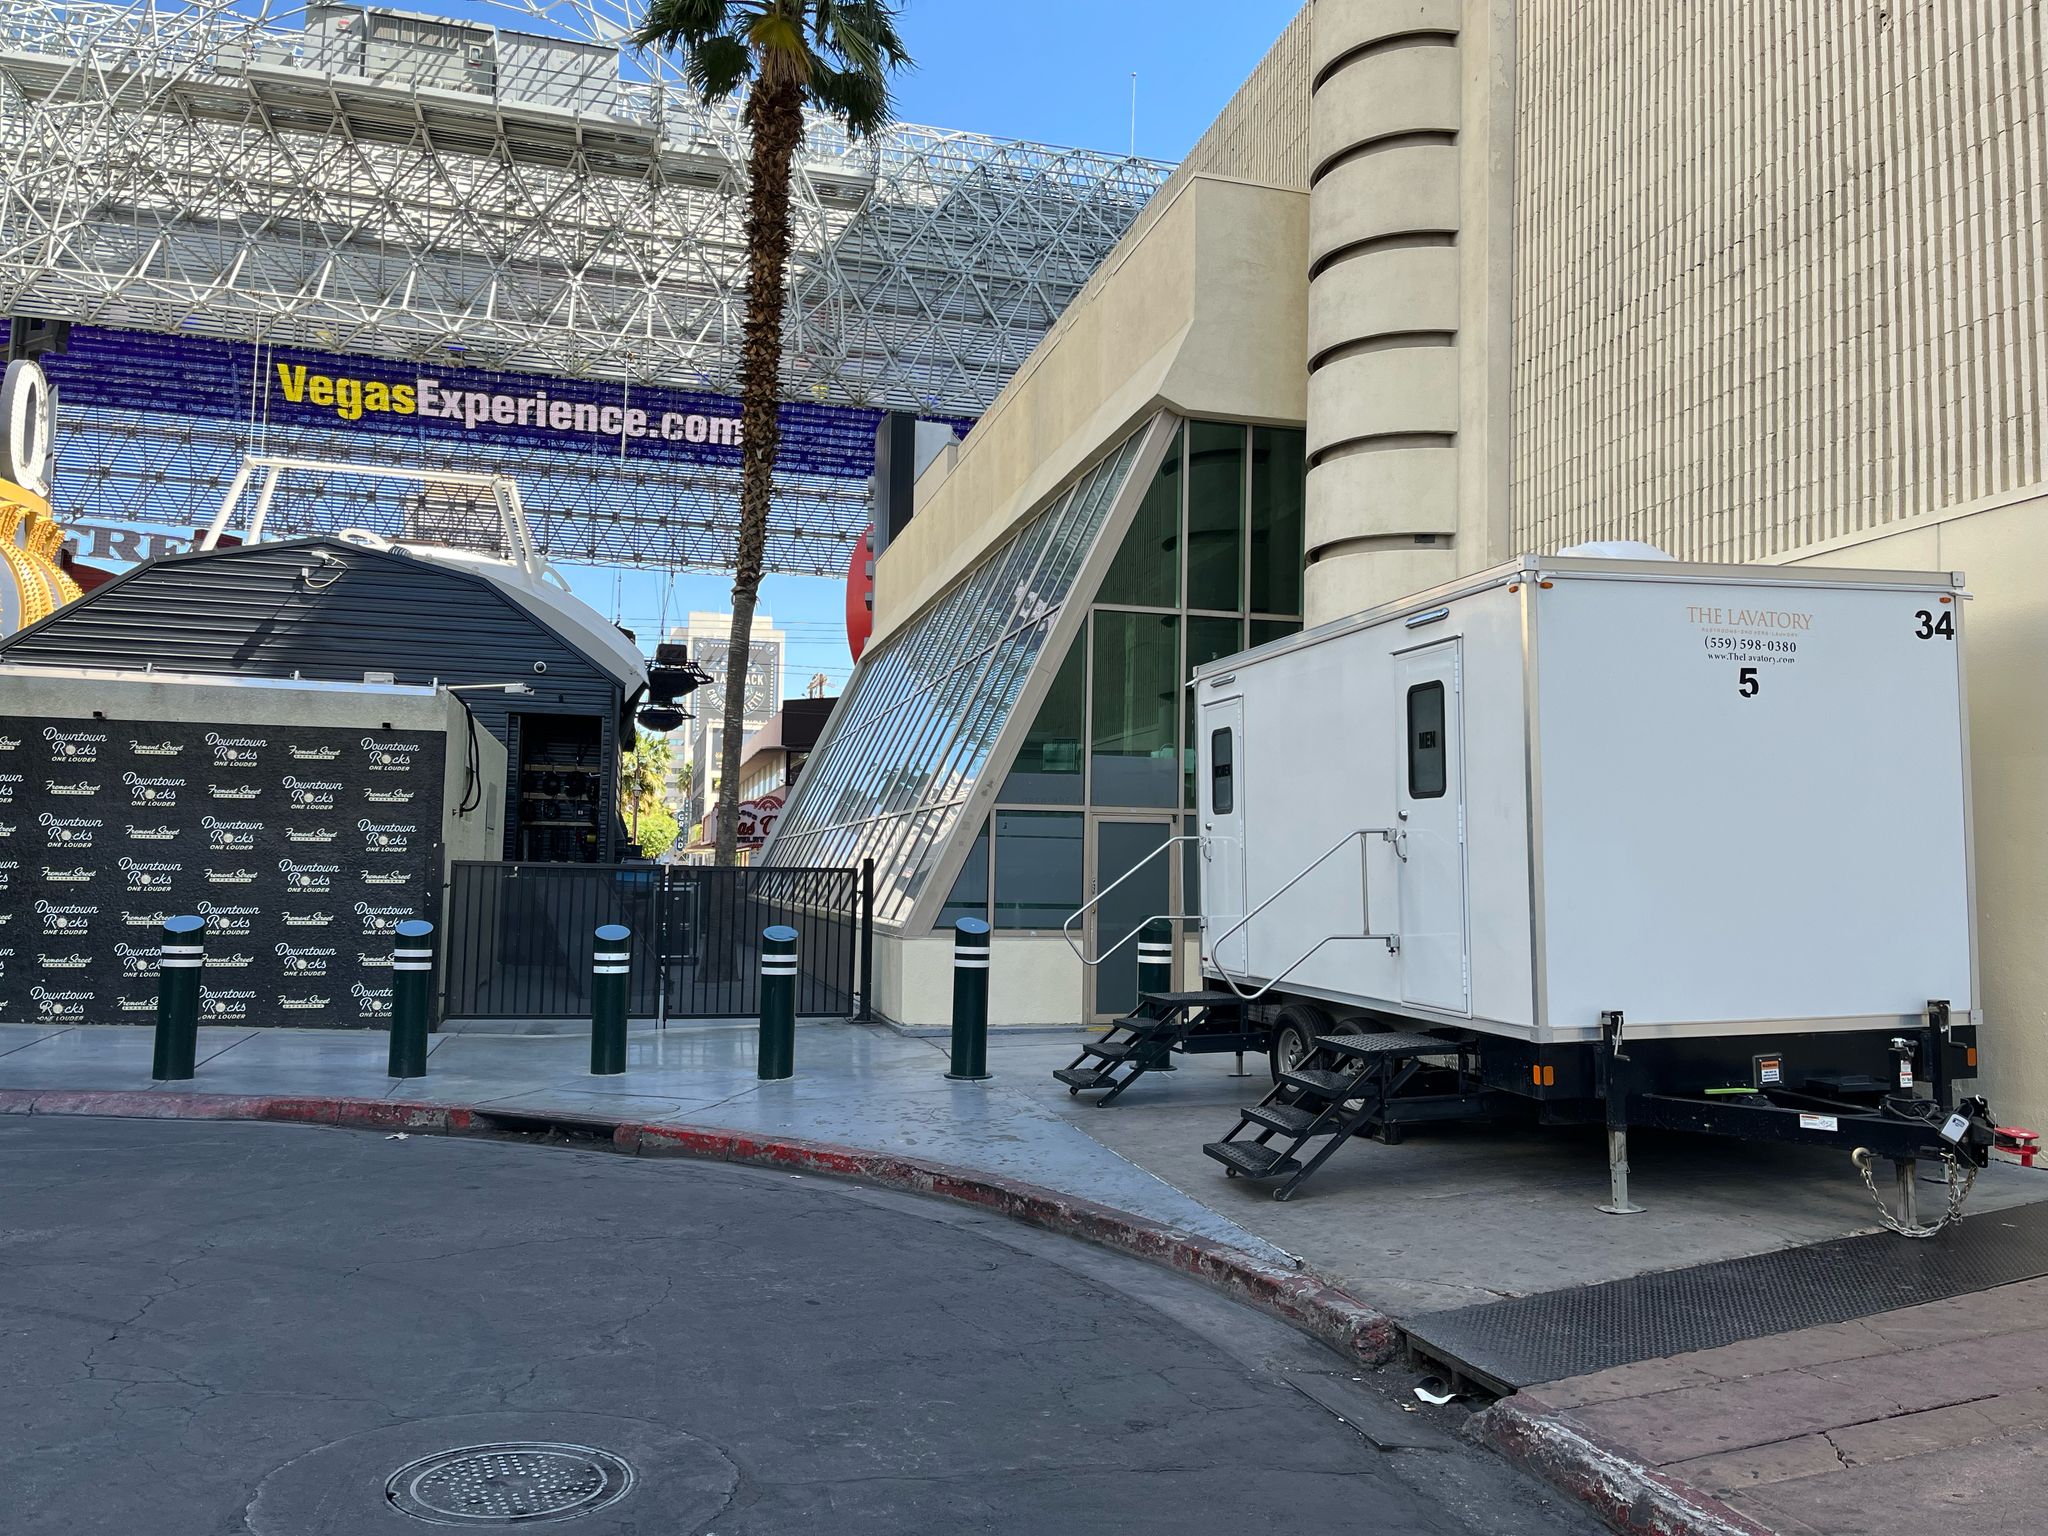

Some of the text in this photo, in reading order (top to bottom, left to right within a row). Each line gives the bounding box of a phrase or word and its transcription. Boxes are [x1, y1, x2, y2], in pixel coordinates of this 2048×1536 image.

[277, 363, 744, 446] VegasExperience.com
[1686, 606, 1813, 630] THE LAVATORY
[1914, 610, 1955, 640] 34
[1704, 636, 1797, 652] (559) 598-0380
[708, 672, 764, 686] BLAACK
[1738, 667, 1760, 698] 5
[43, 727, 107, 742] Downtown
[205, 732, 268, 747] Downtown
[1419, 731, 1436, 749] MEN
[129, 740, 184, 751] Fremont Street
[289, 745, 340, 755] Fremont Street
[361, 737, 420, 751] Downtown
[45, 780, 100, 791] Fremont Street
[123, 772, 187, 786] Downtown
[282, 776, 343, 790] Downtown
[208, 784, 261, 794] Fremont Street
[363, 788, 415, 798] Fremont Street
[39, 813, 103, 827] Downtown
[201, 816, 264, 830] Downtown
[358, 819, 417, 832] Downtown
[125, 825, 179, 835] Fremont Street
[285, 828, 337, 837] Fremont Street
[118, 857, 182, 871] Downtown
[279, 859, 340, 872] Downtown
[41, 867, 96, 877] Fremont Street
[204, 868, 258, 878] Fremont Street
[360, 870, 412, 879] Fremont Street
[34, 900, 99, 914] Downtown
[197, 901, 260, 914] Downtown
[354, 902, 414, 915] Downtown
[121, 911, 151, 921] Fremont
[281, 912, 334, 921] Fremont Street
[114, 943, 161, 956] Downto
[275, 943, 337, 955] Downtown
[37, 954, 92, 963] Fremont Street
[201, 953, 254, 963] Fremont Street
[357, 953, 385, 962] Fremont
[30, 986, 95, 1000] Downtown
[351, 983, 393, 996] Downto
[117, 997, 148, 1006] Fremont
[278, 995, 331, 1004] Fremont Street
